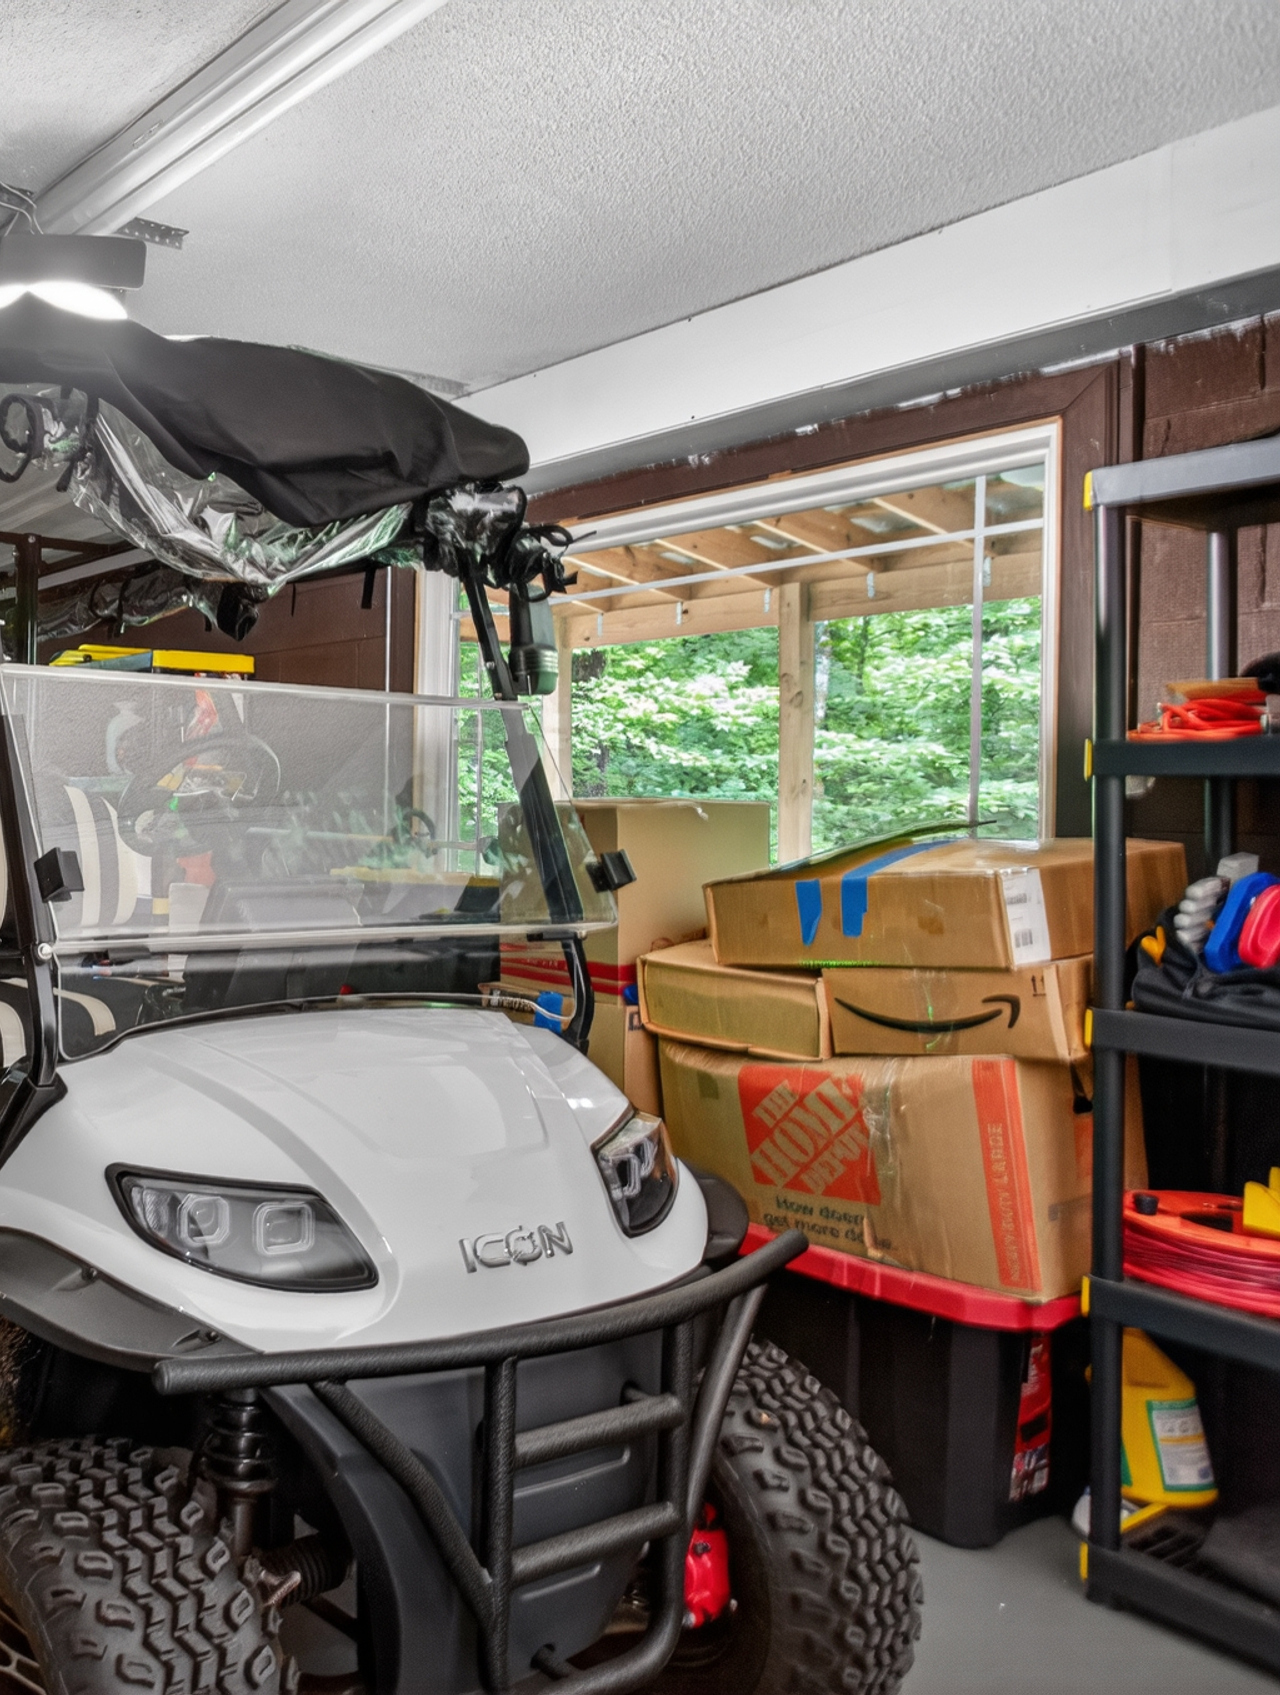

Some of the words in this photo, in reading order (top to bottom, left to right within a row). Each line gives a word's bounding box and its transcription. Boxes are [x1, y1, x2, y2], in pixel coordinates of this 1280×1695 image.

[751, 1079, 798, 1129] THE
[988, 1122, 1008, 1185] LARGE
[458, 1221, 574, 1274] ICON
[794, 1219, 840, 1239] more
